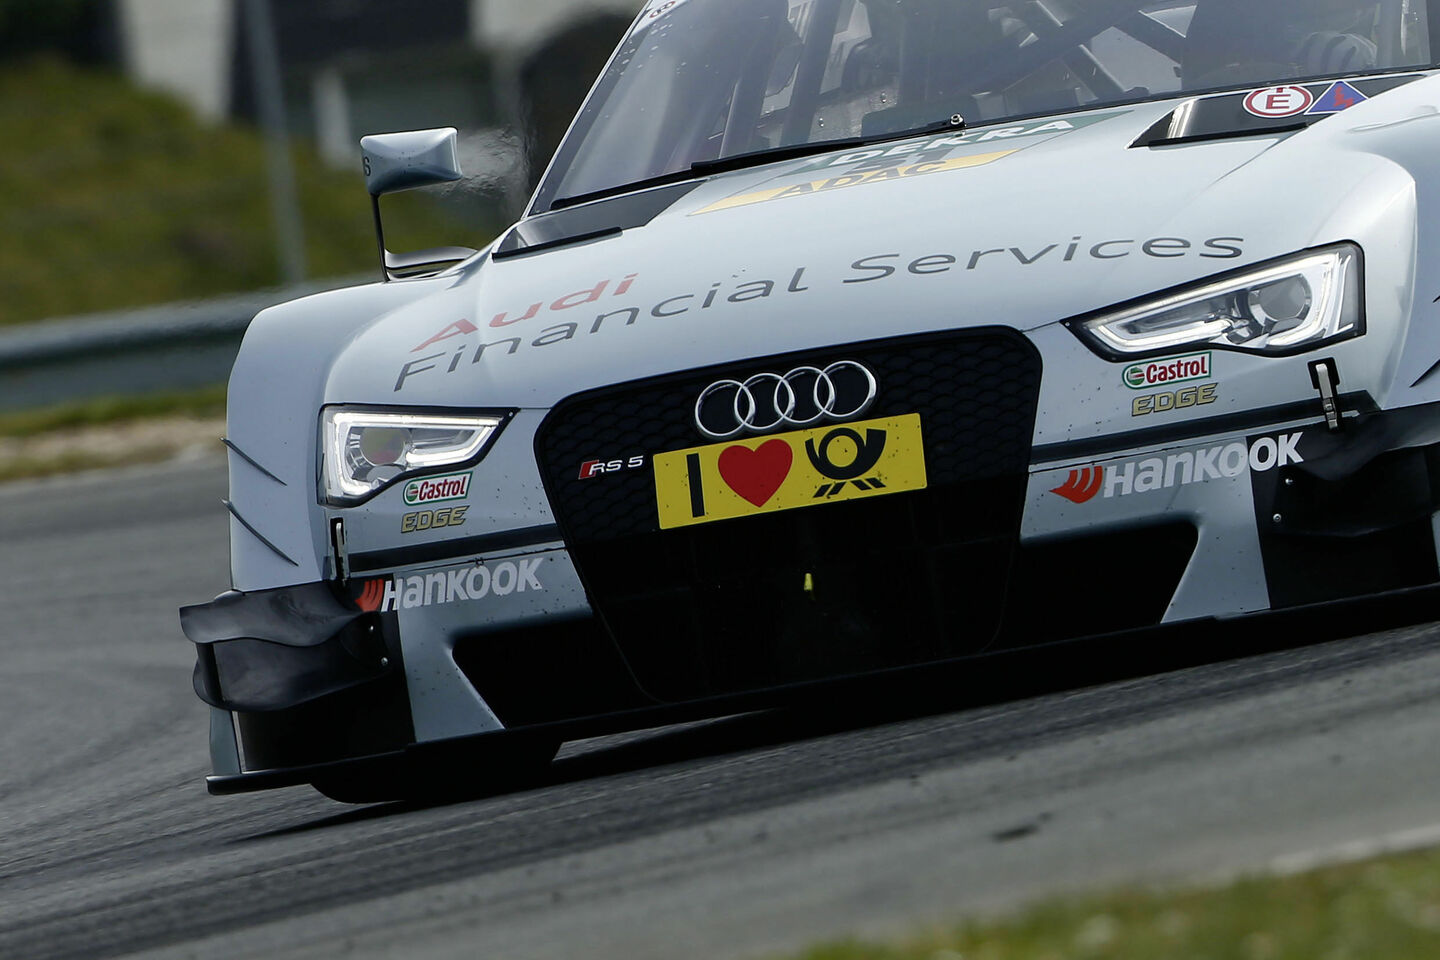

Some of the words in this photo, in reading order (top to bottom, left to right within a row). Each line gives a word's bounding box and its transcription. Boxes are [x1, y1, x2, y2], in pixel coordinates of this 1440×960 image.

[828, 120, 1074, 167] DEKRA
[770, 160, 948, 199] ADAC
[394, 267, 808, 392] Financial
[843, 235, 1244, 284] Services
[410, 273, 639, 352] Audi
[1146, 355, 1208, 383] Castrol
[1132, 382, 1218, 416] EDGE
[588, 459, 623, 476] RS
[627, 456, 644, 468] 5
[418, 476, 466, 501] Castrol
[686, 453, 705, 518] I
[401, 505, 470, 533] EDGE
